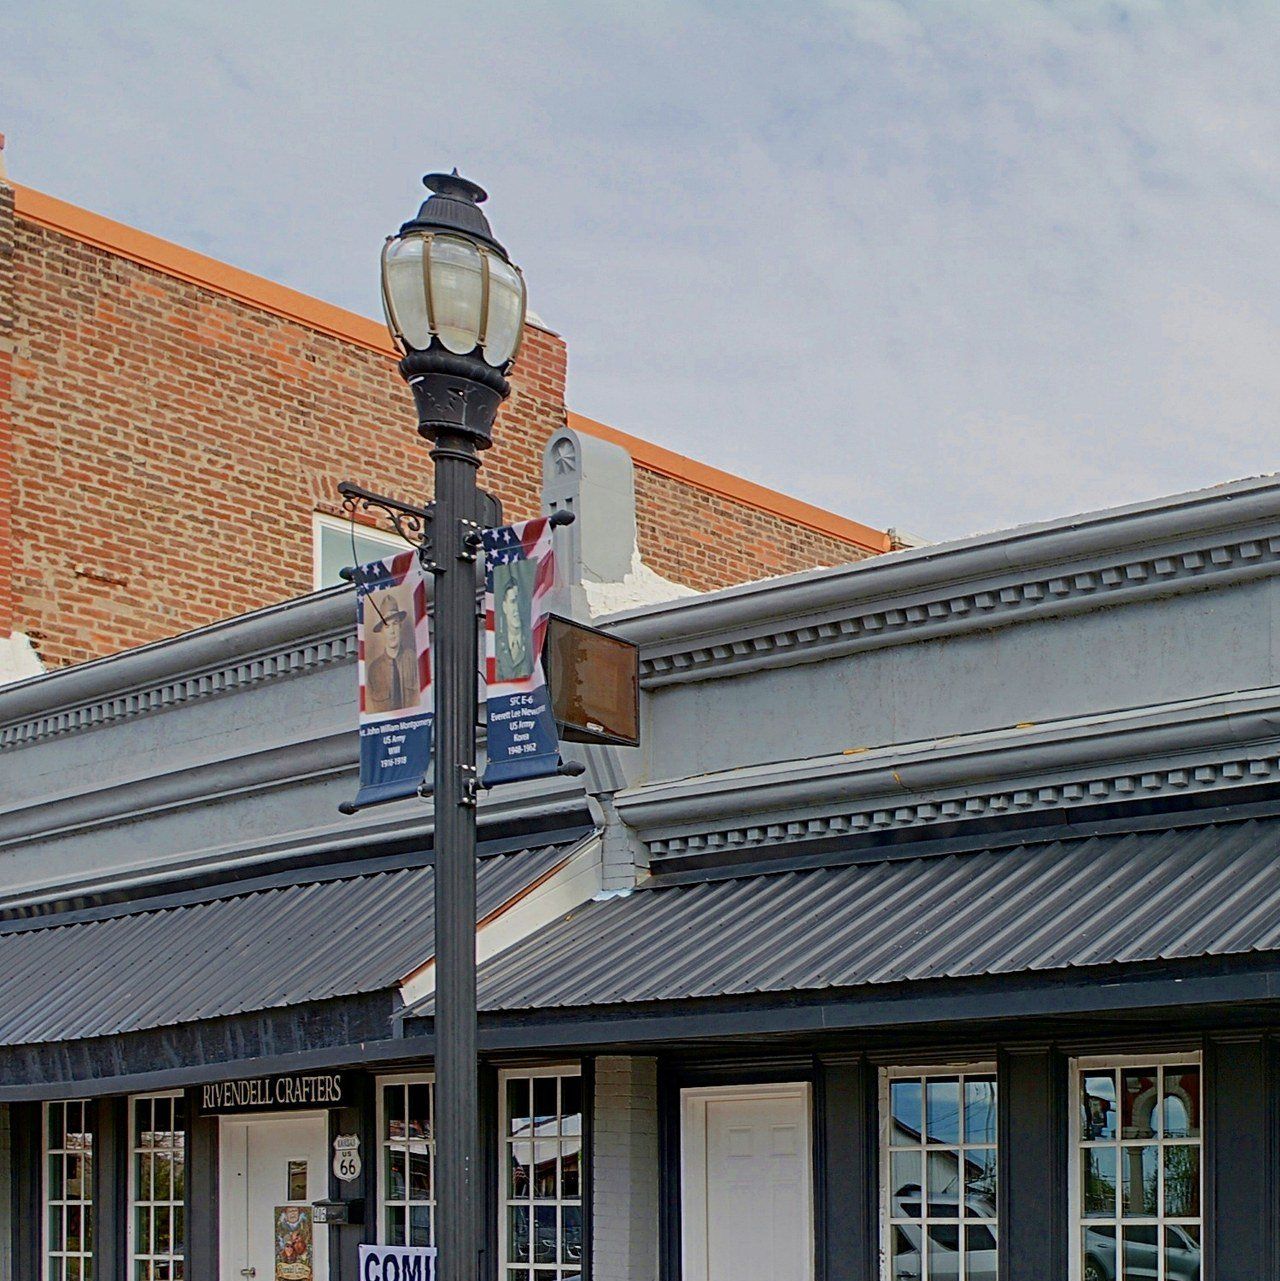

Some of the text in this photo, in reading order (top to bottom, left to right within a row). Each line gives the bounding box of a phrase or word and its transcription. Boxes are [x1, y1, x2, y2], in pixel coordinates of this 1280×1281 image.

[521, 695, 534, 705] E-6
[509, 721, 518, 731] US
[202, 1074, 342, 1109] RIVENDELL CRAFTERS
[340, 1158, 356, 1176] 66
